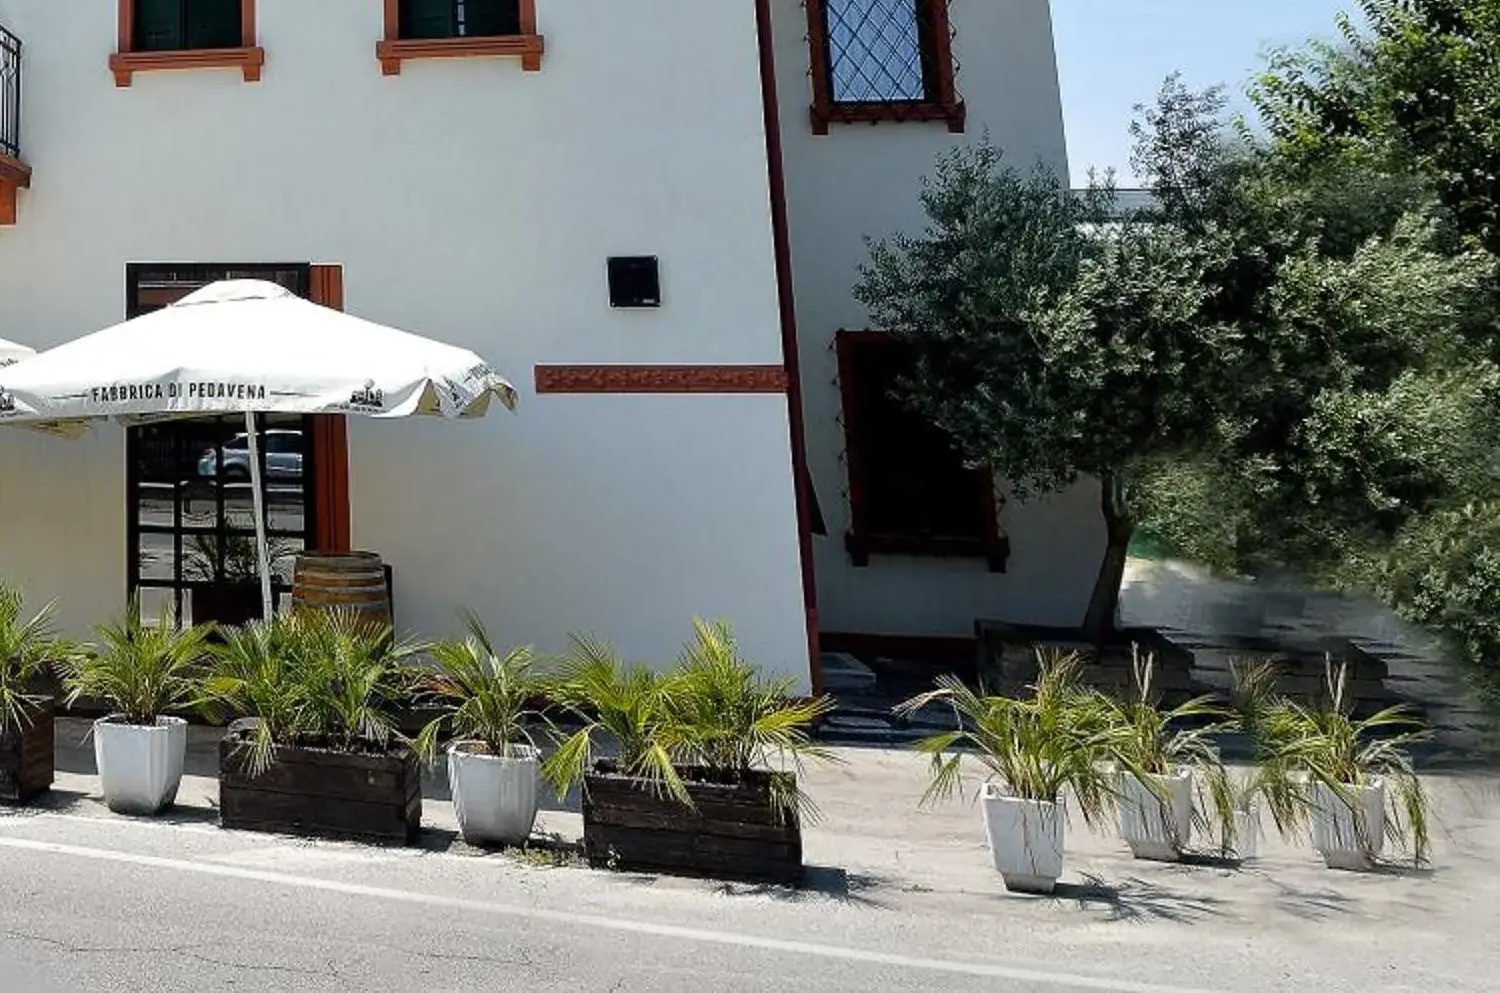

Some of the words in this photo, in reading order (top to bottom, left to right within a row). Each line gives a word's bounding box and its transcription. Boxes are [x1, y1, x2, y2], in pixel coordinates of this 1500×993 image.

[92, 383, 163, 402] FABBRICA
[169, 382, 182, 398] DI
[189, 382, 265, 399] PEDAVENA
